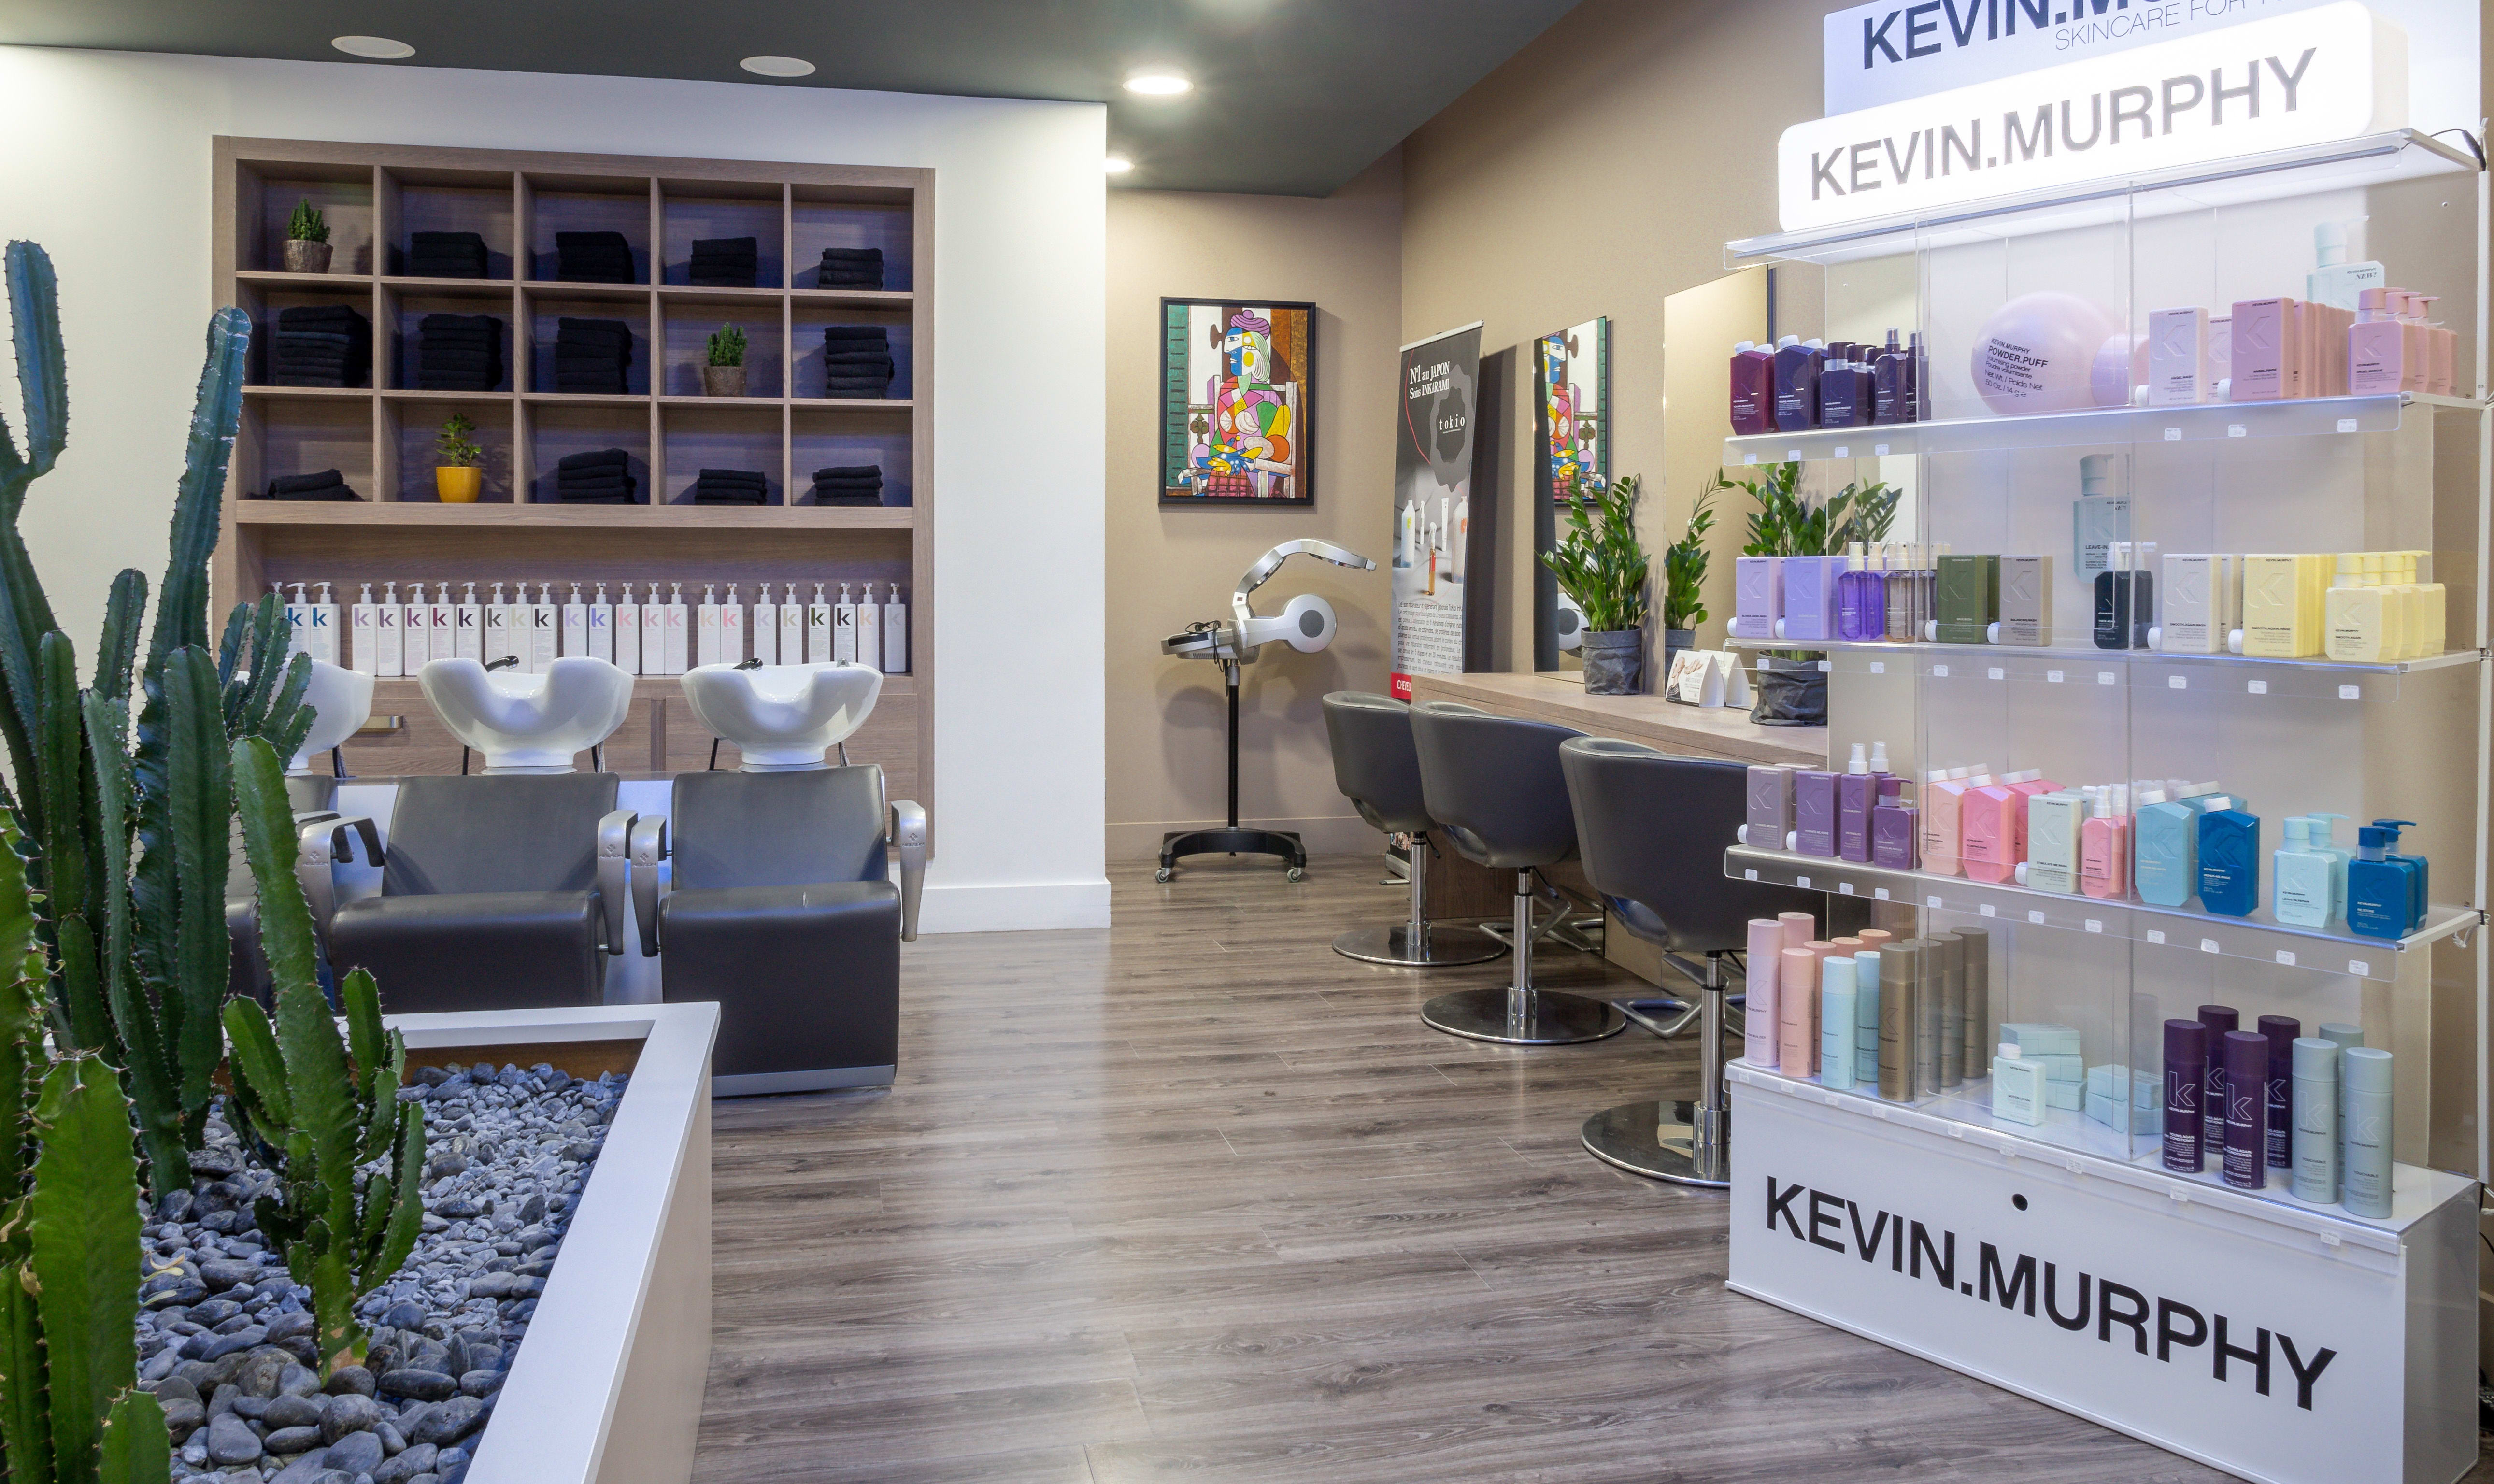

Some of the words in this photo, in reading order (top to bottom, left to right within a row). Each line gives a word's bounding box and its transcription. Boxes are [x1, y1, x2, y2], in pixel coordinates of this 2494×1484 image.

[1864, 0, 2162, 69] KEVIN.
[2055, 2, 2180, 50] SKINCARE
[1810, 46, 2317, 201] KEVIN.MURPHY
[1991, 338, 2031, 354] KEVIN.MURPHY
[1988, 346, 2048, 367] POWDER.PUFF
[1422, 371, 1429, 381] au
[1430, 361, 1450, 381] JAPON
[2010, 364, 2031, 372] powder
[1422, 378, 1450, 396] INKARAMI
[2009, 378, 2027, 388] Poids
[1439, 414, 1465, 430] tokio
[1766, 1174, 2337, 1411] KEVIN.MURPHY
